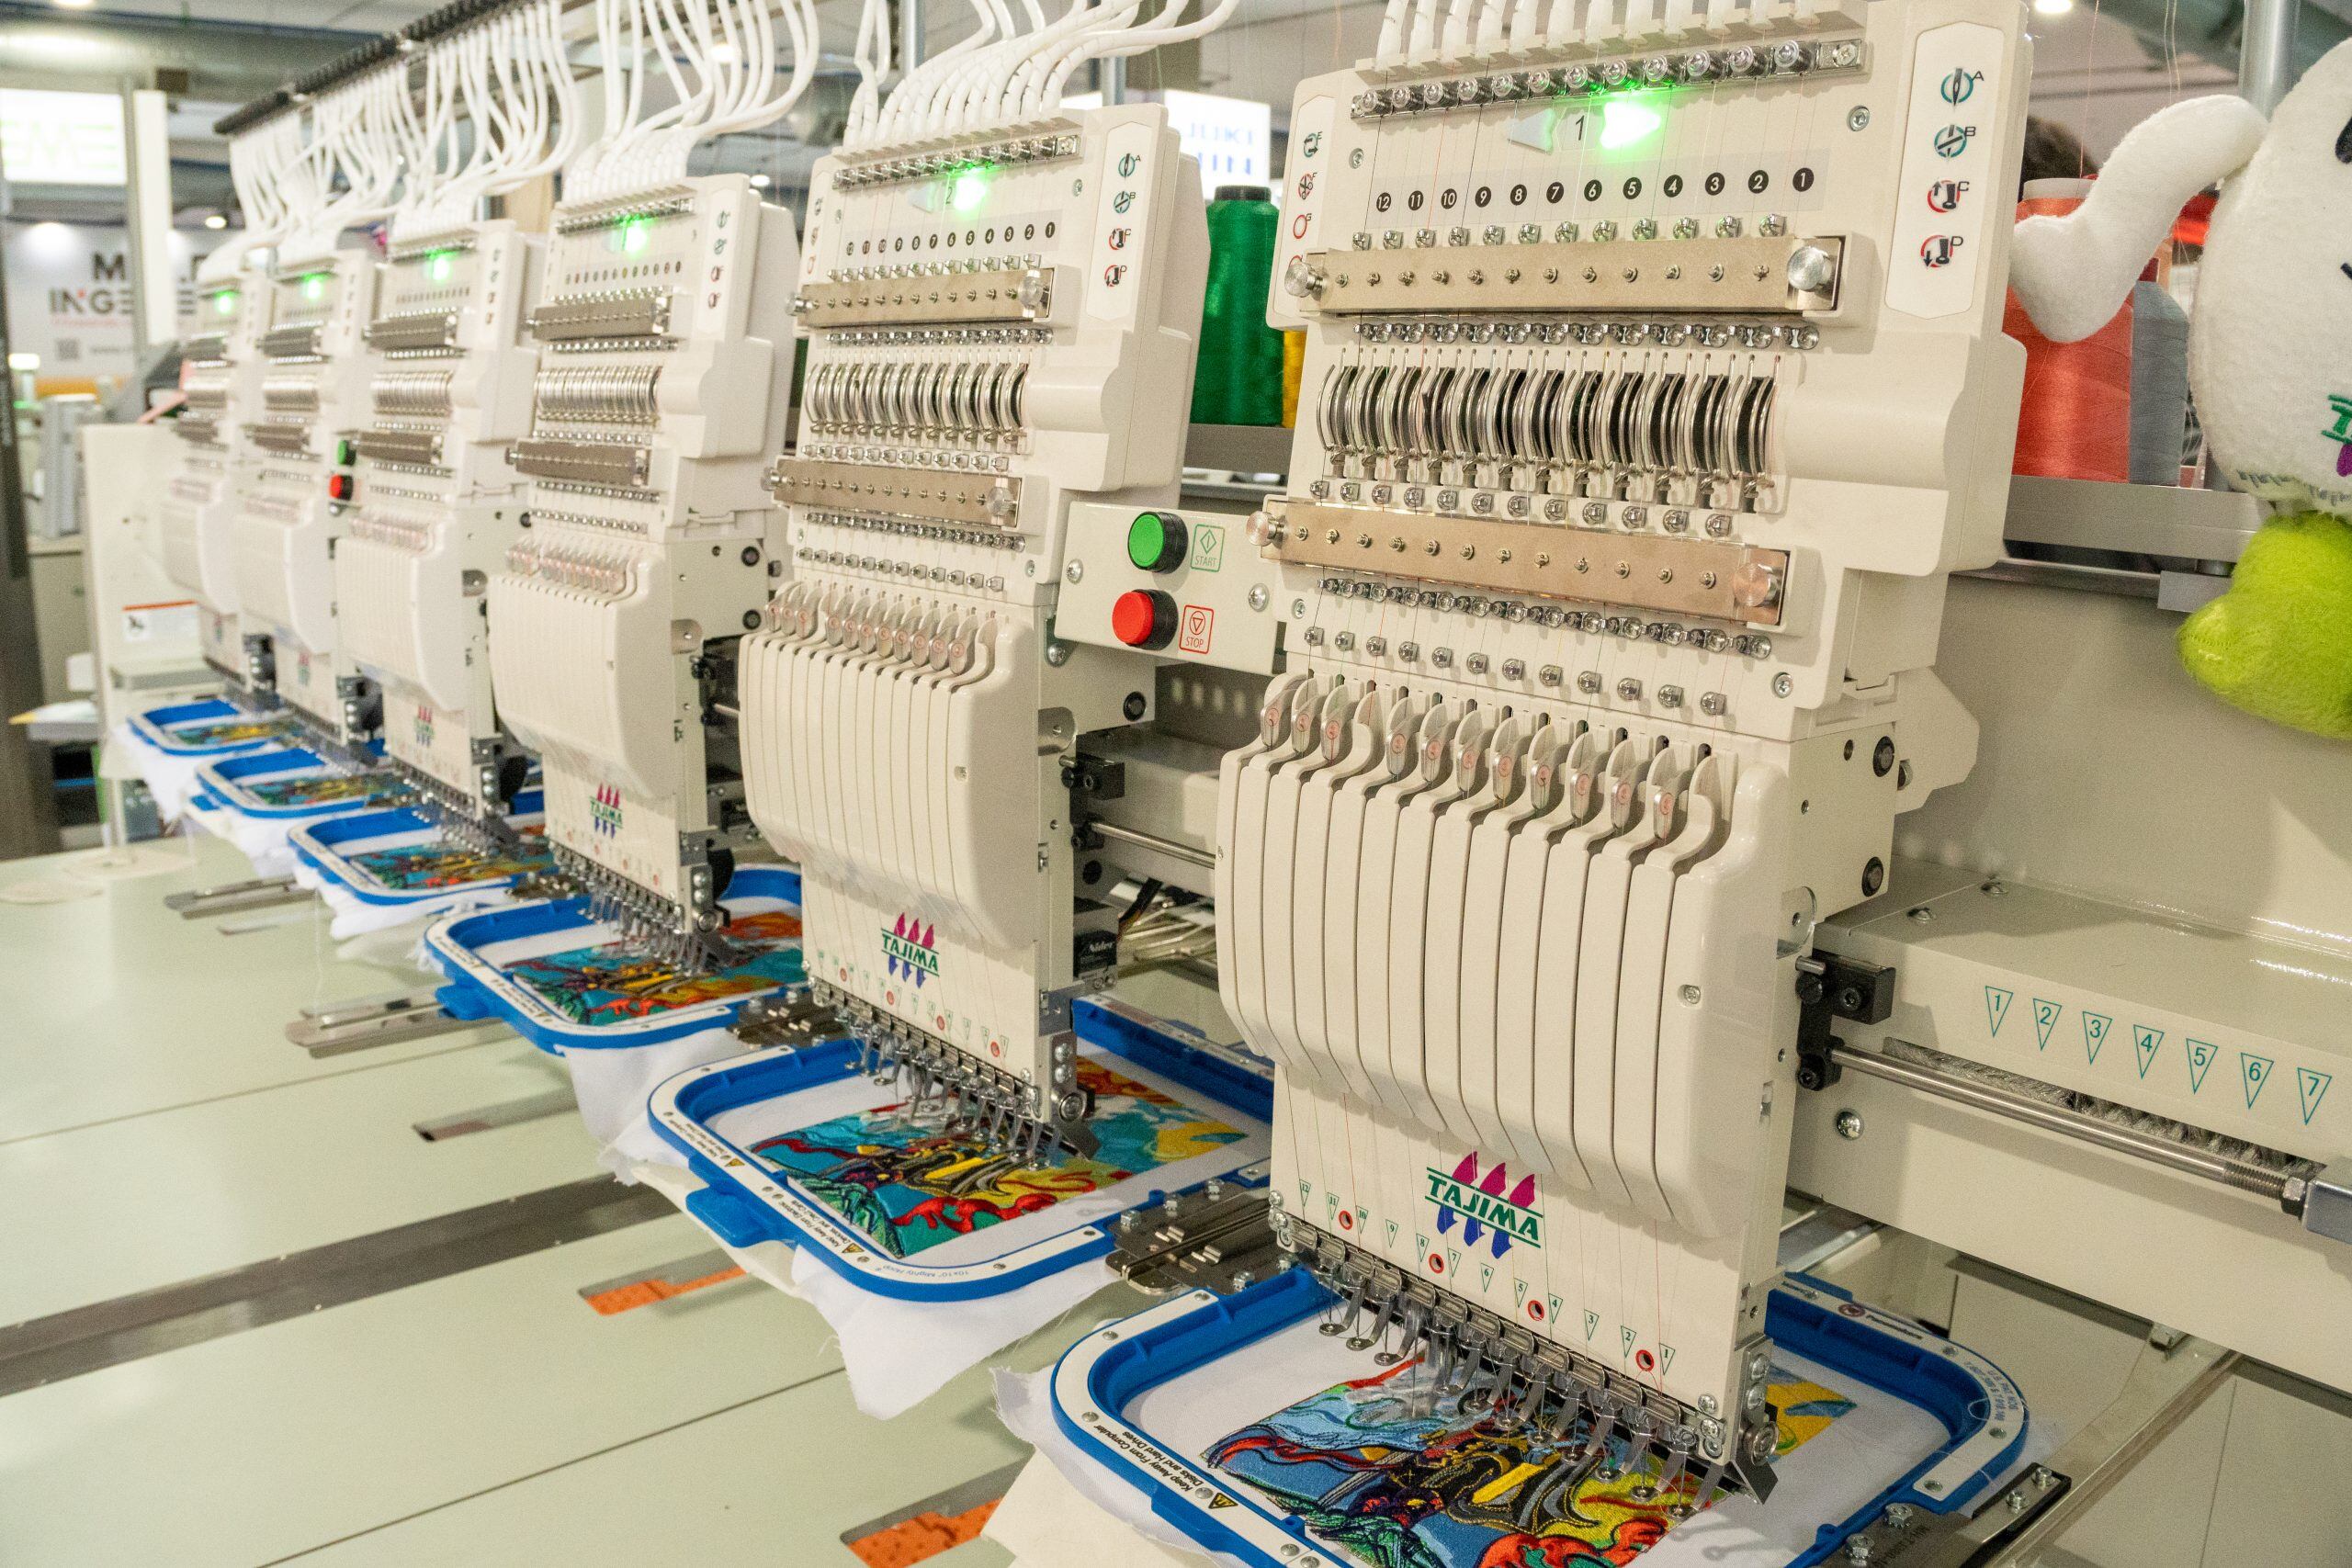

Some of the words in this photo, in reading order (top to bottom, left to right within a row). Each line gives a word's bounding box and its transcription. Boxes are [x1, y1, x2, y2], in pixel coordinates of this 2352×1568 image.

[1972, 71, 1984, 82] A
[1576, 115, 1585, 141] 1
[1965, 126, 1976, 137] B
[1958, 181, 1970, 192] C
[945, 186, 953, 204] 2
[1951, 236, 1964, 247] D
[1195, 555, 1217, 568] START
[1185, 637, 1204, 649] STOP
[882, 932, 938, 972] TAJIMA
[1995, 994, 2001, 1011] 1
[2040, 1006, 2052, 1025] 2
[2089, 1020, 2101, 1038] 3
[2141, 1033, 2153, 1052] 4
[2194, 1046, 2207, 1066] 5
[2249, 1062, 2262, 1081] 6
[2308, 1076, 2320, 1097] 7
[1428, 1174, 1539, 1241] TAJIMA
[1301, 1183, 1309, 1193] 12
[1329, 1196, 1338, 1205] 11
[1358, 1209, 1367, 1220] 10
[1389, 1224, 1395, 1233] 9
[1419, 1238, 1425, 1247] 8
[1452, 1253, 1457, 1261] 7
[1518, 1283, 1523, 1292] 5
[1552, 1299, 1558, 1308] 4
[1589, 1315, 1594, 1324] 3
[1625, 1332, 1632, 1341] 2
[1664, 1349, 1668, 1359] 1
[1093, 1425, 1130, 1450] Computer
[1123, 1431, 1148, 1449] Drives
[1129, 1448, 1151, 1463] From
[1145, 1447, 1166, 1461] Hard
[1148, 1461, 1172, 1477] Away
[1164, 1460, 1182, 1471] and
[1170, 1475, 1193, 1492] Keep
[1180, 1470, 1204, 1486] Disks
